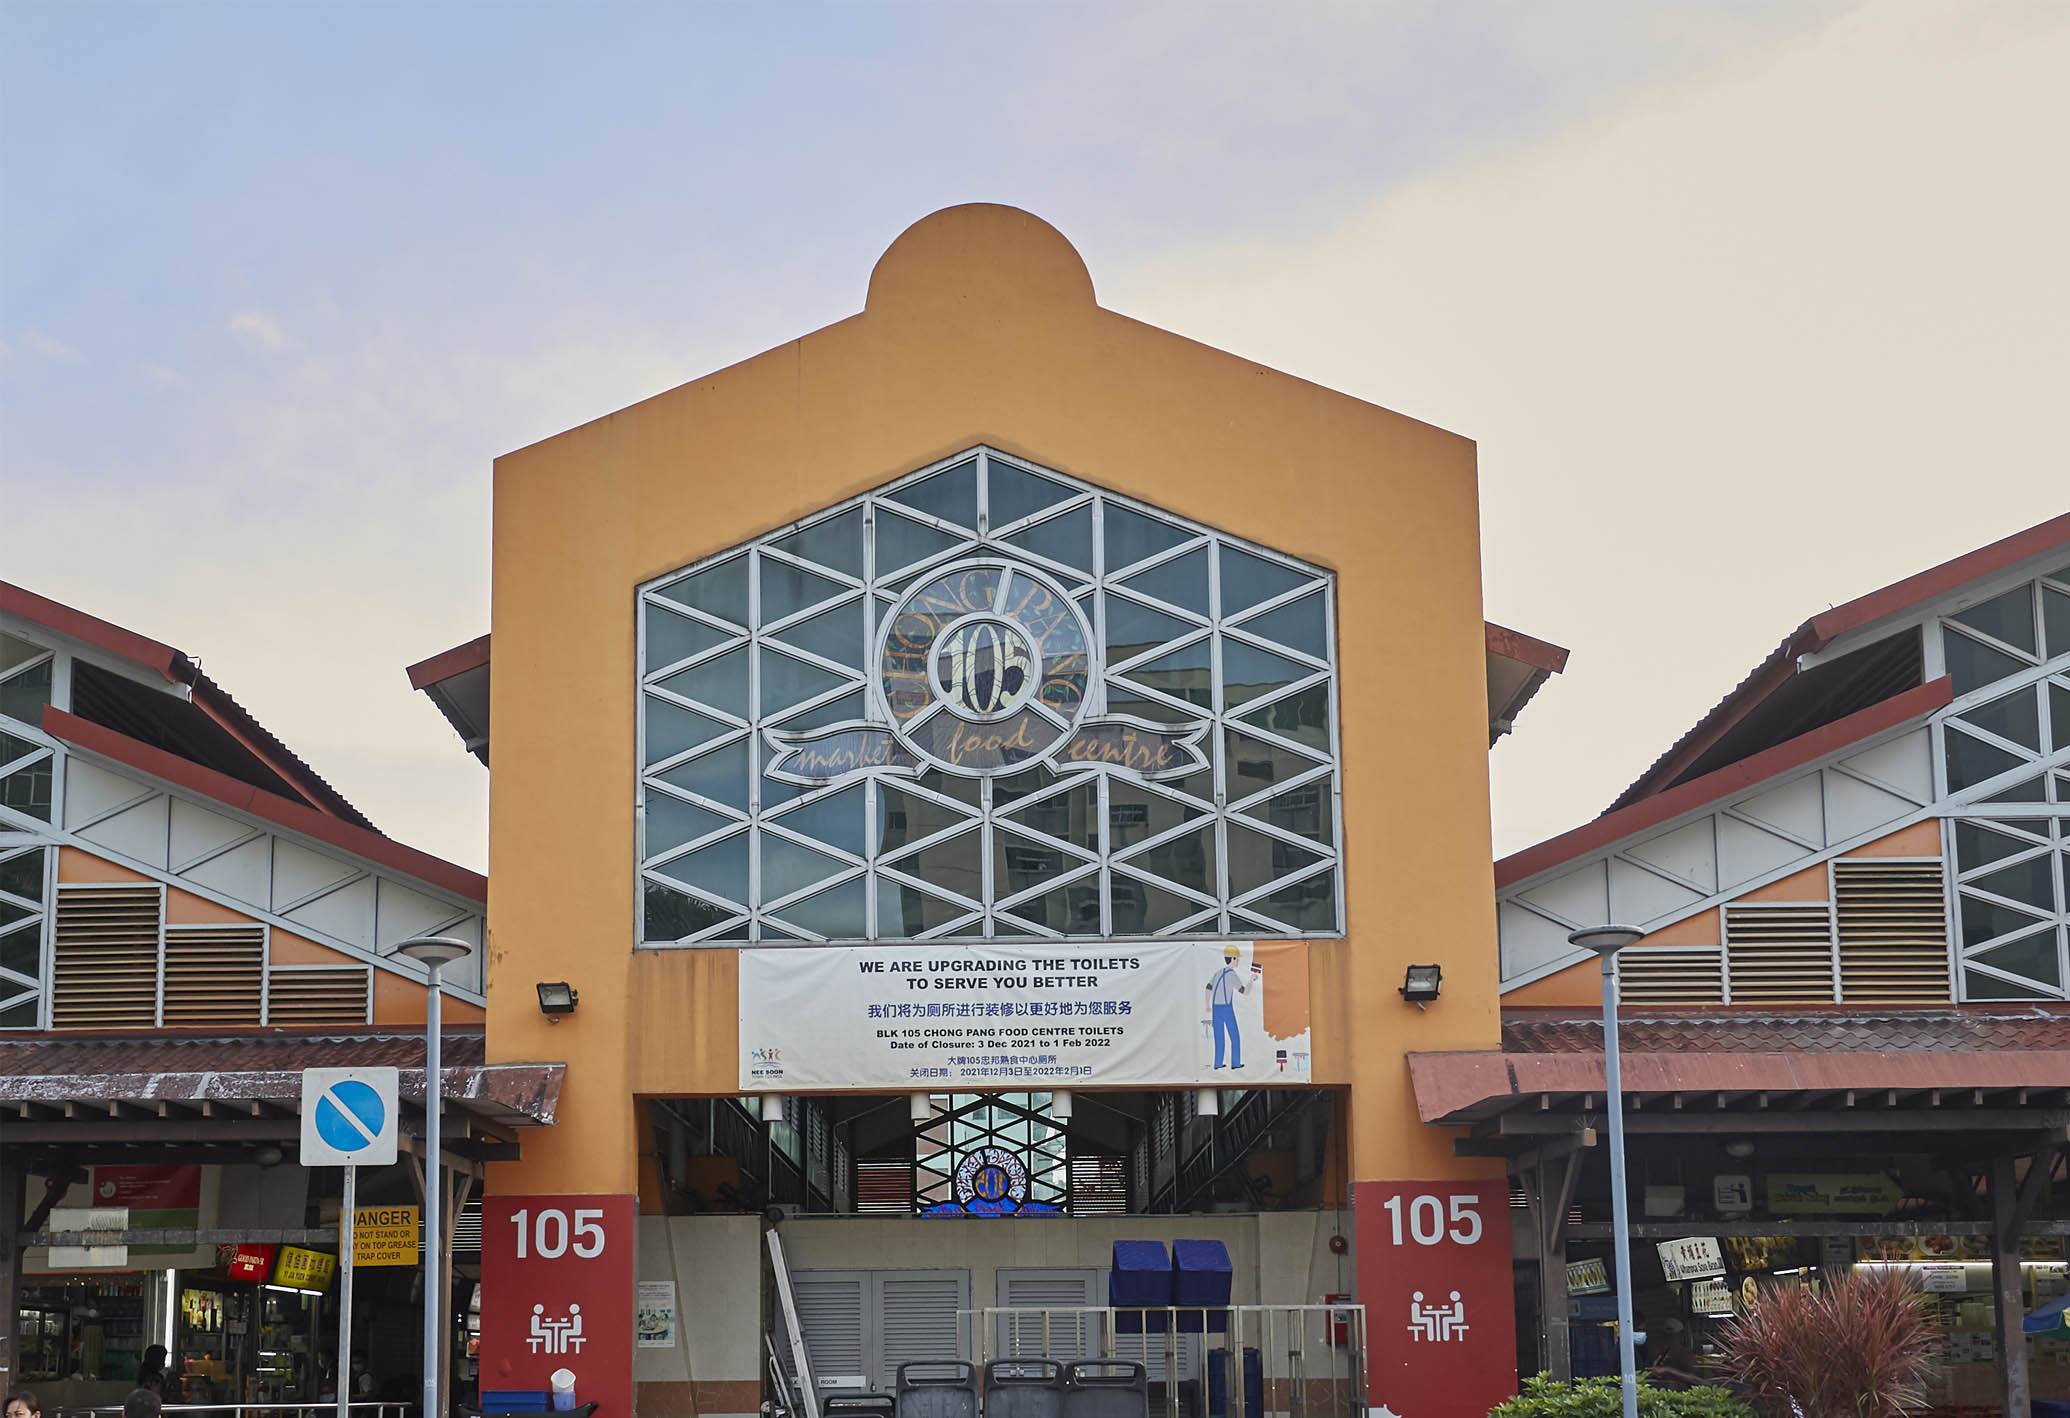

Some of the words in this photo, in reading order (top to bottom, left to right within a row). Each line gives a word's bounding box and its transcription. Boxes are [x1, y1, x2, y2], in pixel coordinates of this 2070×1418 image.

[939, 624, 1031, 713] 105
[793, 732, 899, 770] market
[945, 717, 1033, 765] food
[1067, 732, 1175, 770] centre
[859, 961, 885, 973] WE
[889, 960, 923, 973] ARE
[928, 959, 1027, 972] UPGRADING
[1031, 959, 1065, 971] THE
[1070, 958, 1140, 970] TOILETS
[906, 978, 929, 990] TO
[934, 977, 988, 989] SERVE
[993, 976, 1028, 989] YOU
[1033, 976, 1098, 988] BETTER
[868, 1001, 1132, 1018] 我们将为厕所进行装修以更好地为您服务
[876, 1029, 899, 1038] BLK
[901, 1029, 921, 1038] 105
[924, 1028, 963, 1038] CHONG
[966, 1028, 996, 1037] PANG
[999, 1027, 1029, 1037] FOOD
[1031, 1027, 1076, 1036] CENTRE
[1078, 1026, 1124, 1036] TOILETS
[890, 1040, 915, 1049] Date
[917, 1040, 928, 1049] of
[931, 1040, 975, 1049] Closure:
[978, 1040, 984, 1048] 3
[987, 1040, 1008, 1048] Dec
[1011, 1039, 1035, 1048] 2021
[1039, 1039, 1050, 1048] to
[1053, 1039, 1059, 1047] 1
[1063, 1038, 1082, 1047] Feb
[1085, 1038, 1111, 1047] 2022
[353, 1210, 411, 1226] ANGER
[1383, 1194, 1483, 1246] 105
[359, 1231, 374, 1240] NOT
[375, 1230, 399, 1239] STAND
[399, 1230, 410, 1238] OR
[510, 1208, 606, 1259] 105
[360, 1242, 371, 1250] ON
[373, 1242, 387, 1250] TOP
[388, 1240, 417, 1249] GREASE
[357, 1252, 376, 1260] TRAP
[376, 1251, 401, 1260] COVER
